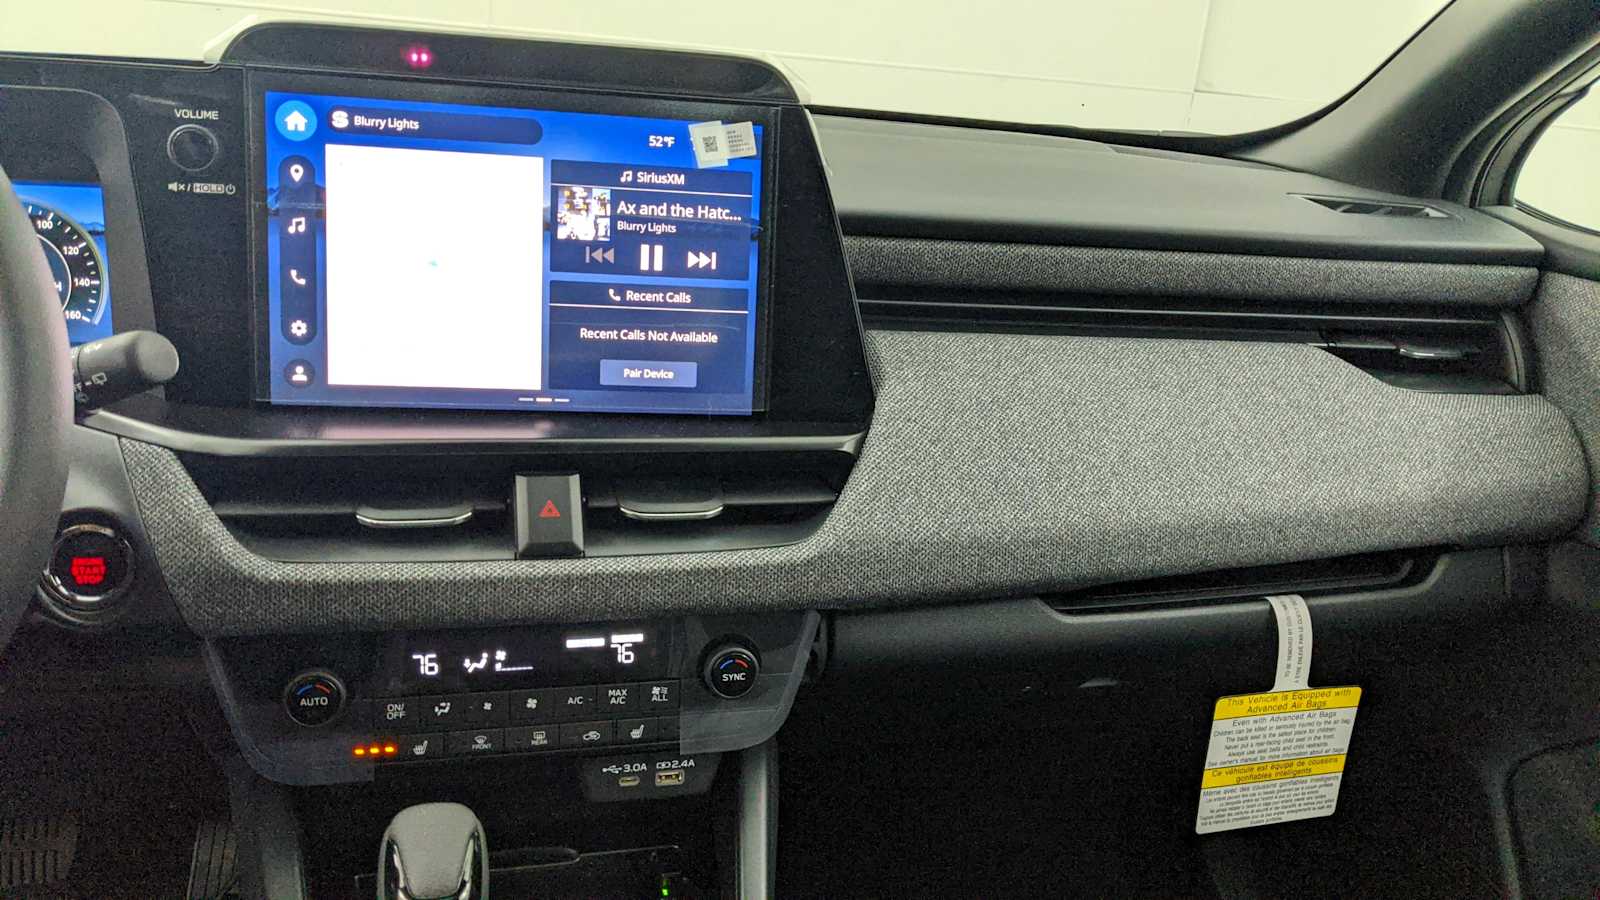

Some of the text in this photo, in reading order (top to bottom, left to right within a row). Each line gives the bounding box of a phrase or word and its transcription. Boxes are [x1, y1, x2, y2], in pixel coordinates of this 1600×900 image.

[174, 108, 219, 120] VOLUME
[354, 115, 419, 131] Blurry Lights
[636, 171, 685, 185] SiriusXM
[193, 182, 225, 194] HOLD
[616, 200, 636, 216] Ax
[639, 202, 667, 218] and
[670, 205, 694, 219] the
[36, 220, 53, 230] 100
[616, 220, 678, 235] Blurry Lights
[62, 246, 79, 256] 120
[73, 278, 91, 287] 140
[626, 290, 692, 304] Recent Calls
[64, 310, 82, 321] 160
[579, 328, 719, 344] Recent Calls Not Available
[623, 368, 675, 380] Pair Device
[610, 643, 636, 664] 76
[411, 653, 440, 676] 76
[721, 672, 747, 683] SYNC
[608, 689, 628, 697] MAX
[651, 694, 669, 703] ALL
[1228, 698, 1244, 706] This
[1248, 694, 1278, 704] Vehicle
[1292, 690, 1331, 701] Equipped
[1334, 688, 1352, 697] with
[299, 697, 329, 707] AUTO
[567, 696, 584, 706] A/C
[610, 697, 627, 705] A/C
[1247, 699, 1327, 713] Advanced Air Bags
[387, 703, 405, 712] ON/
[386, 711, 406, 720] OFF
[1232, 710, 1337, 727] Even with Advanced Air Bags
[471, 743, 492, 751] FRONT
[623, 763, 648, 774] 3.0A
[671, 759, 696, 770] 2.4A
